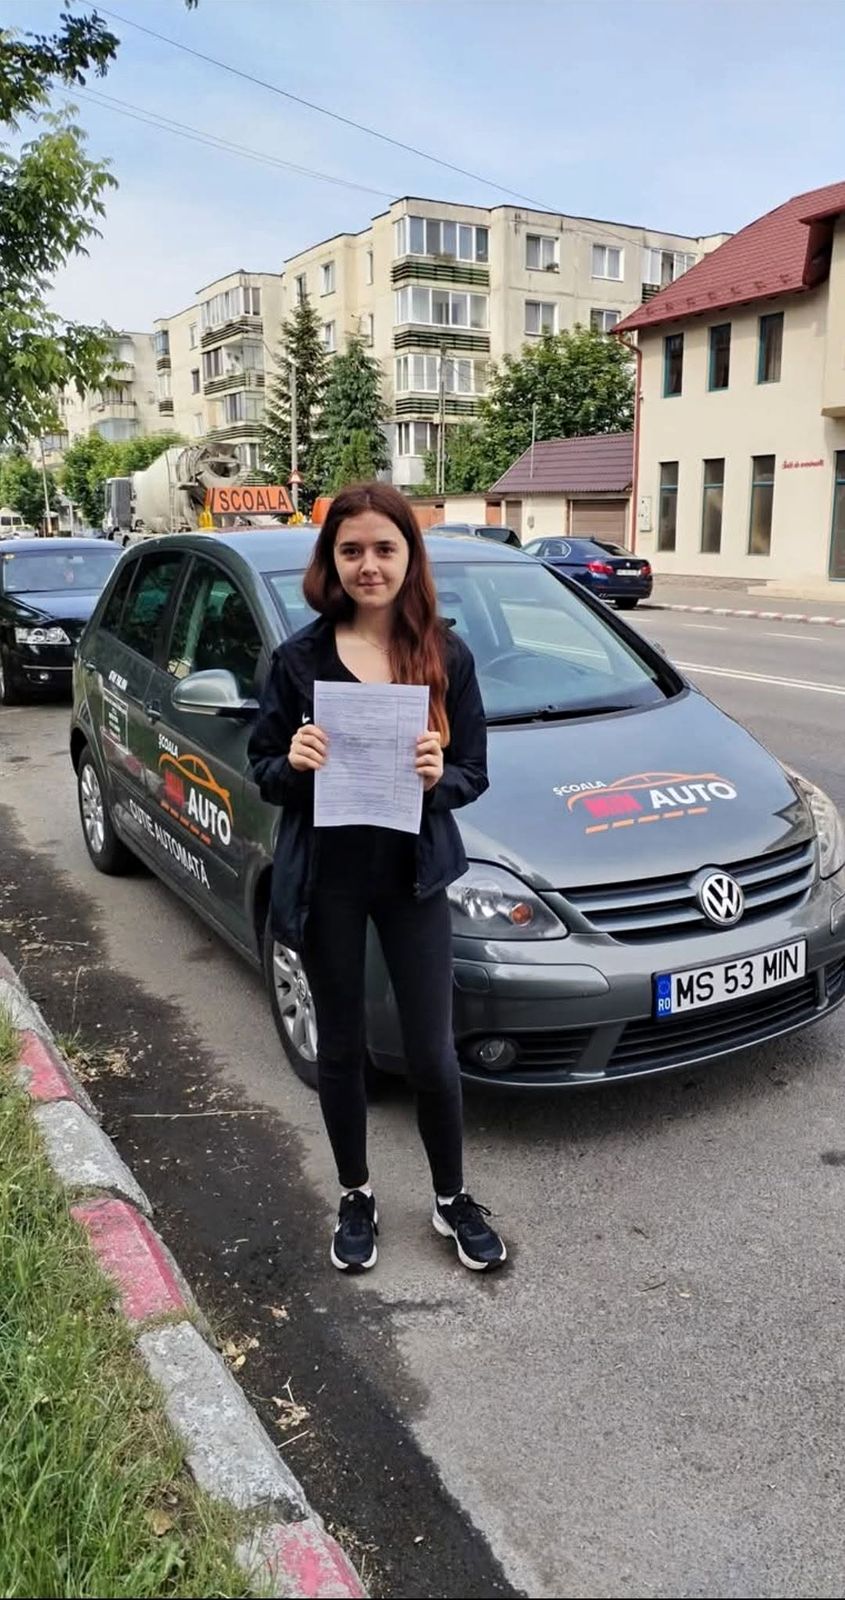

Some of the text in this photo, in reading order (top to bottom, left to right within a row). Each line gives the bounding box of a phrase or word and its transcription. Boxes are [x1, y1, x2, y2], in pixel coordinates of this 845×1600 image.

[219, 489, 288, 511] SCOALA
[649, 781, 738, 809] AUTO
[129, 799, 156, 837] CUTIE
[187, 787, 232, 846] AUTO
[676, 945, 799, 1007] MS 53 MIN
[658, 997, 671, 1012] RO
